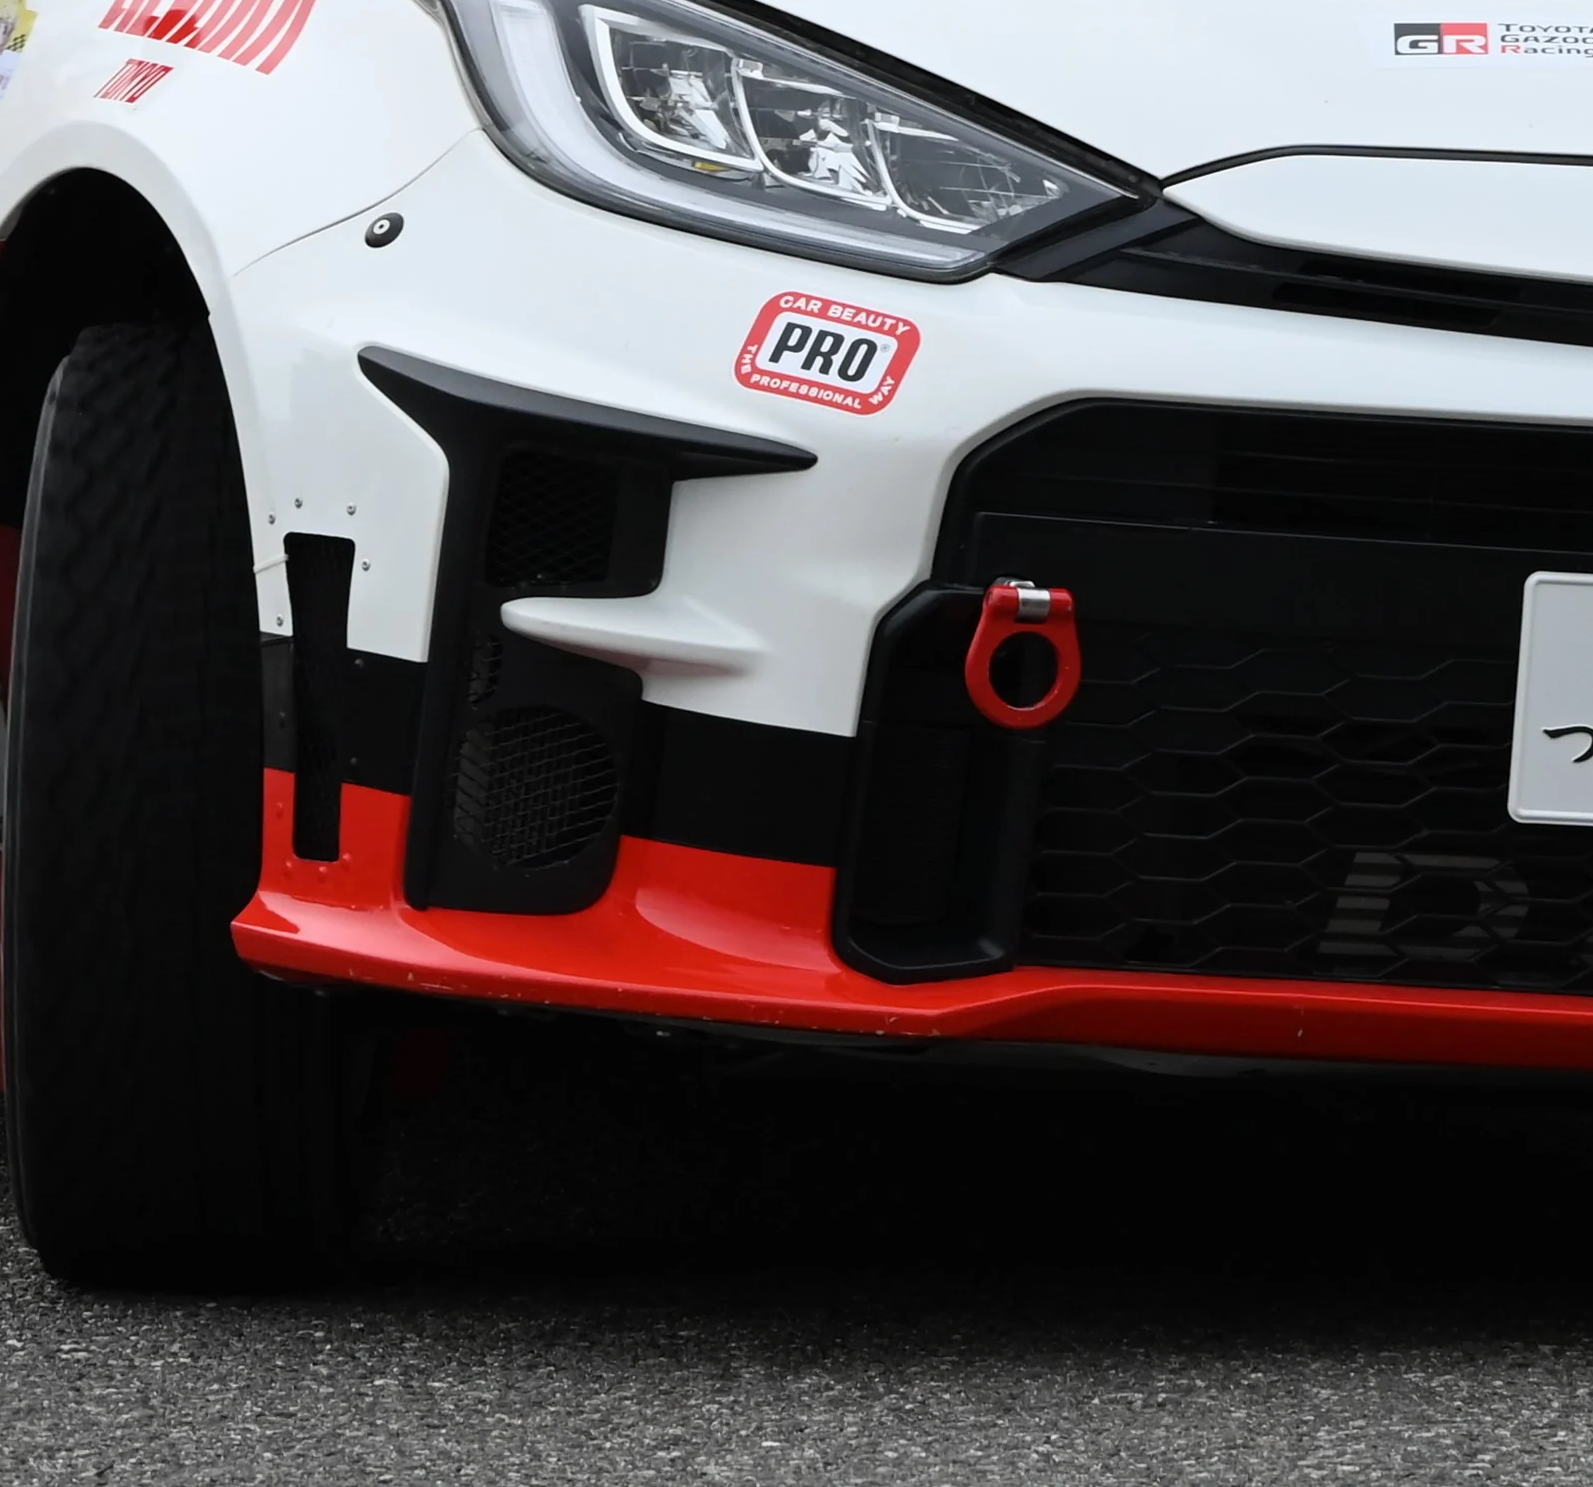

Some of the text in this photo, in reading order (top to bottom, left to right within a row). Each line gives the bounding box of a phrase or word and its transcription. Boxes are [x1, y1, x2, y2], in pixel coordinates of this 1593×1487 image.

[1395, 33, 1487, 55] GR
[779, 295, 911, 336] CAR BEAUTY
[740, 343, 897, 410] THE PROFESSIONAL WAY
[768, 321, 879, 383] PRO
